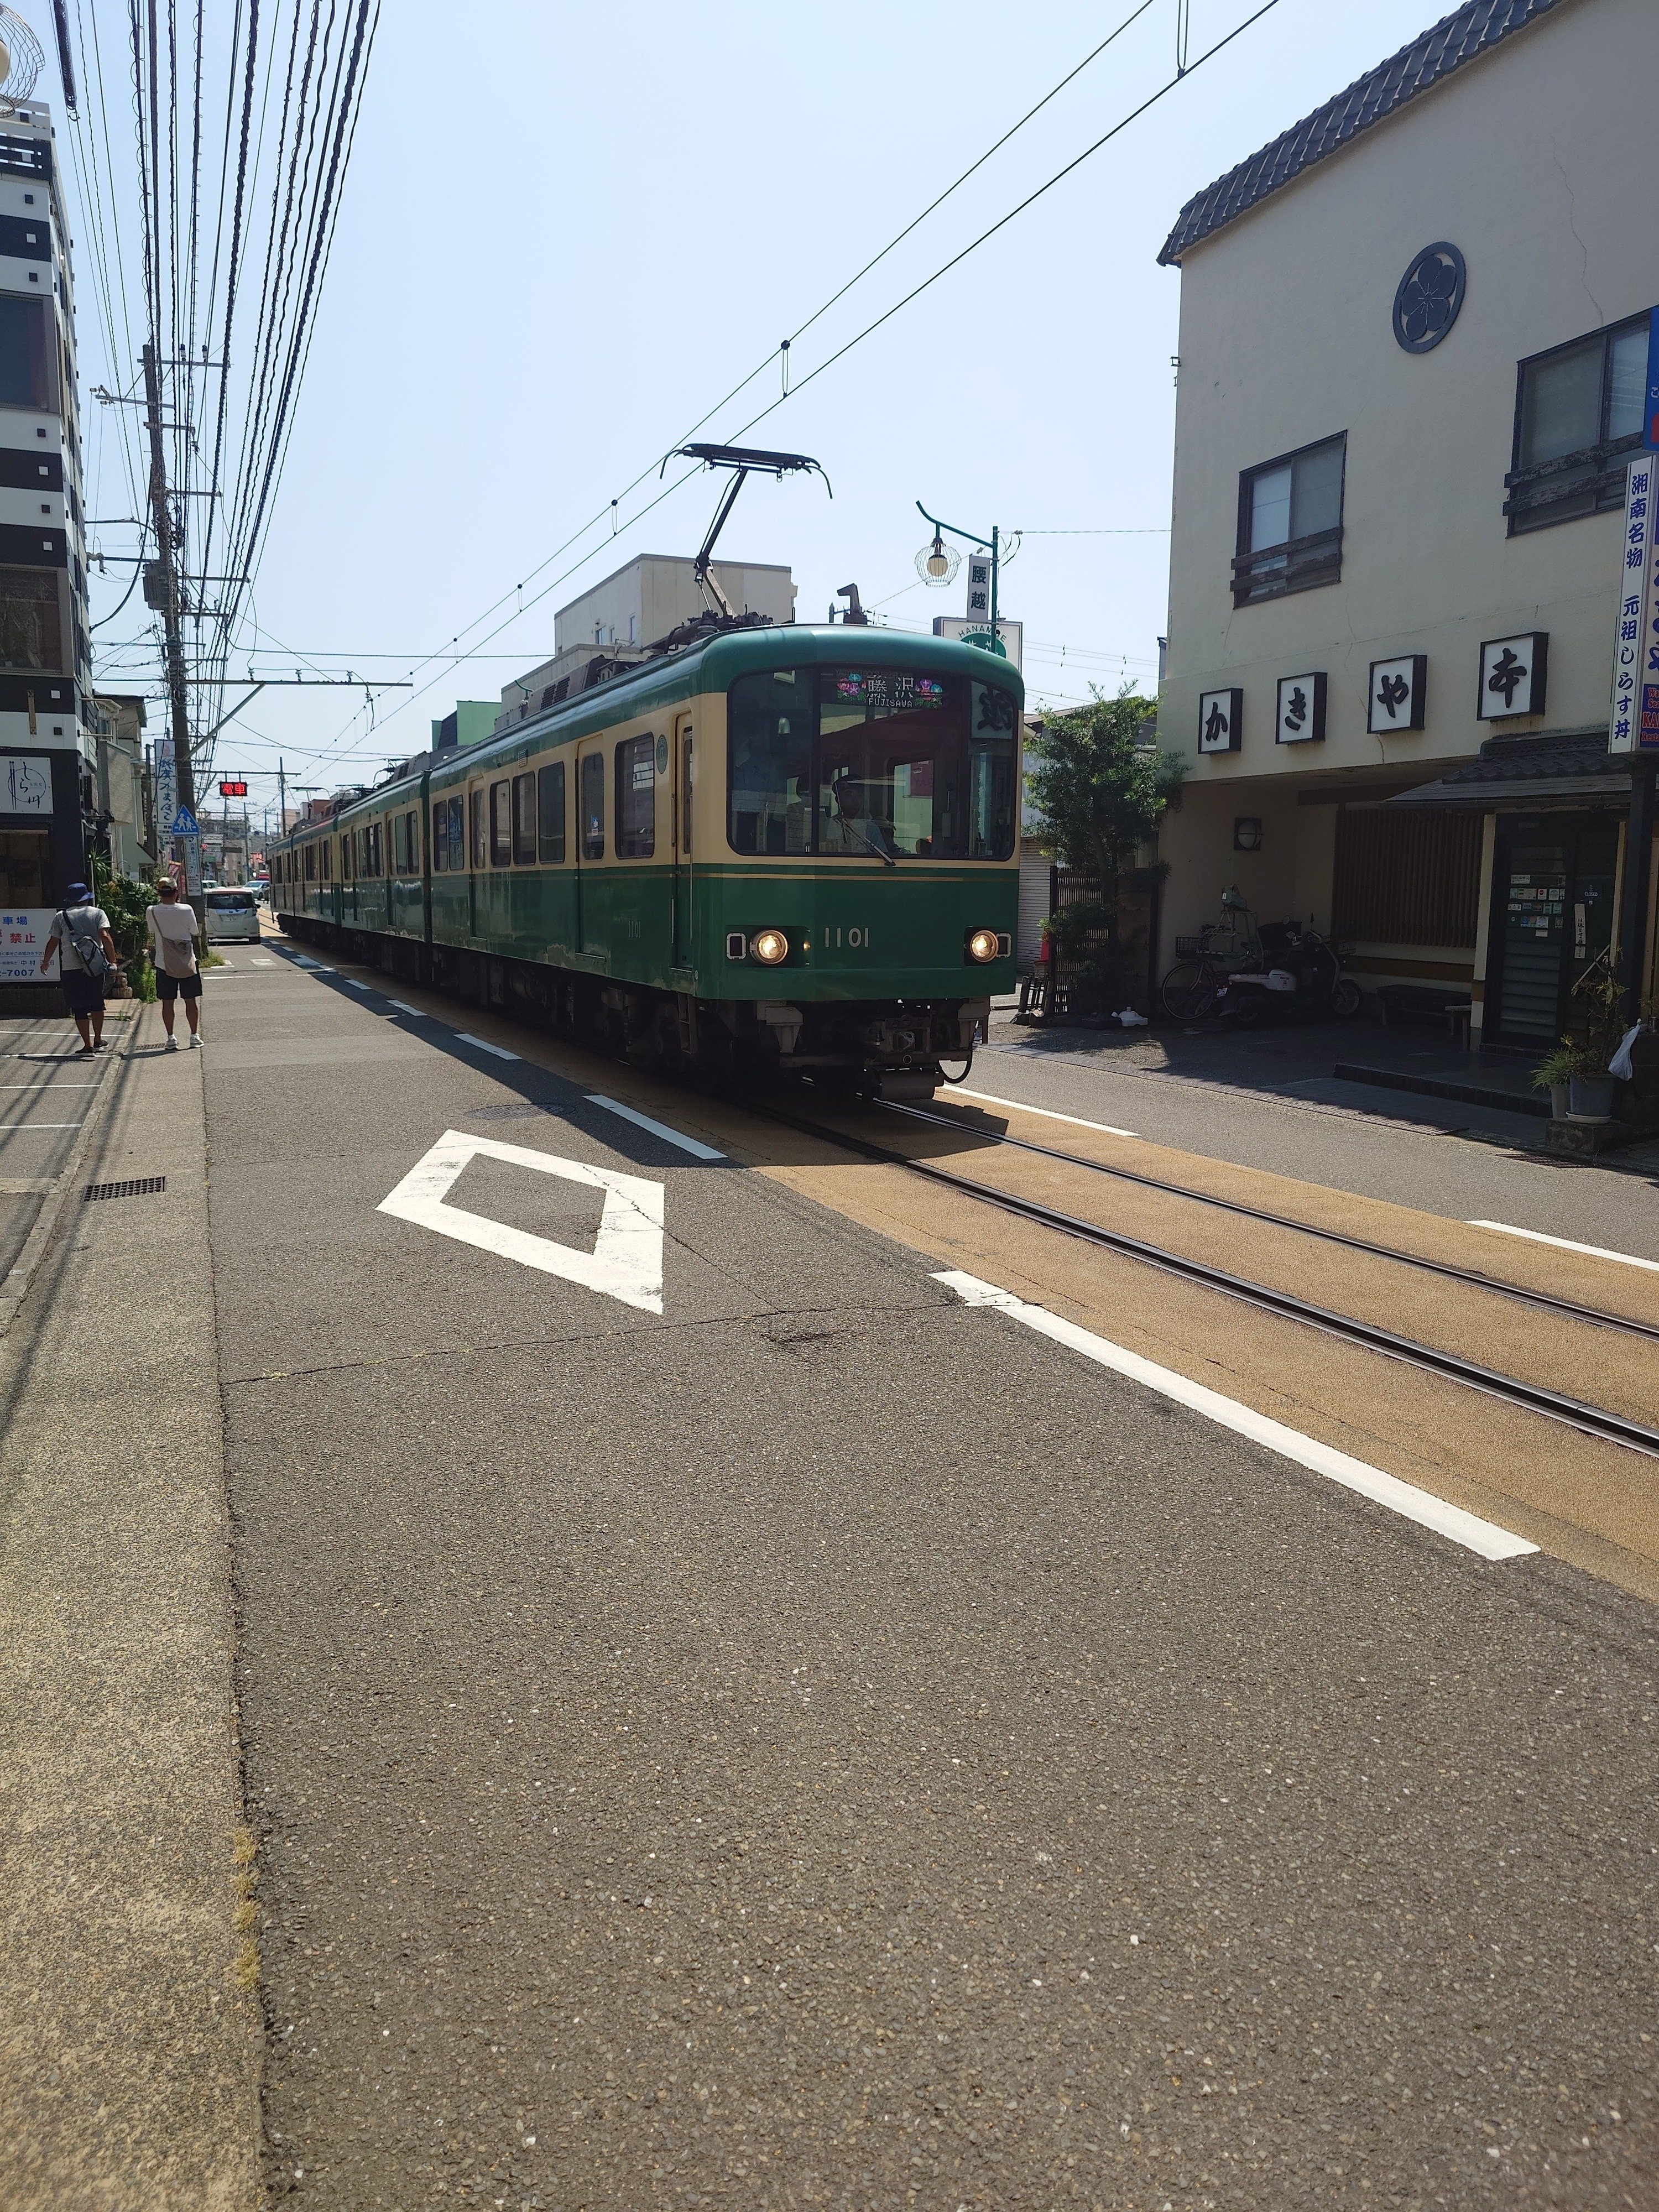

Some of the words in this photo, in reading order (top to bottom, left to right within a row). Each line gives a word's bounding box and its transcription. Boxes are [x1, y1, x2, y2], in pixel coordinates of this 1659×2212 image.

[1625, 472, 1648, 570] 湘南名物
[971, 565, 987, 610] 腰越
[958, 625, 1006, 643] HANAME
[1614, 594, 1640, 740] 元祖しらす丼
[866, 675, 914, 700] 藤沢
[868, 698, 912, 708] FUJISAWA
[1642, 711, 1659, 728] KA
[221, 783, 245, 795] 電車
[3, 916, 28, 925] 車場
[629, 920, 641, 938] 1101
[10, 933, 36, 943] 禁止
[825, 927, 869, 947] 1101
